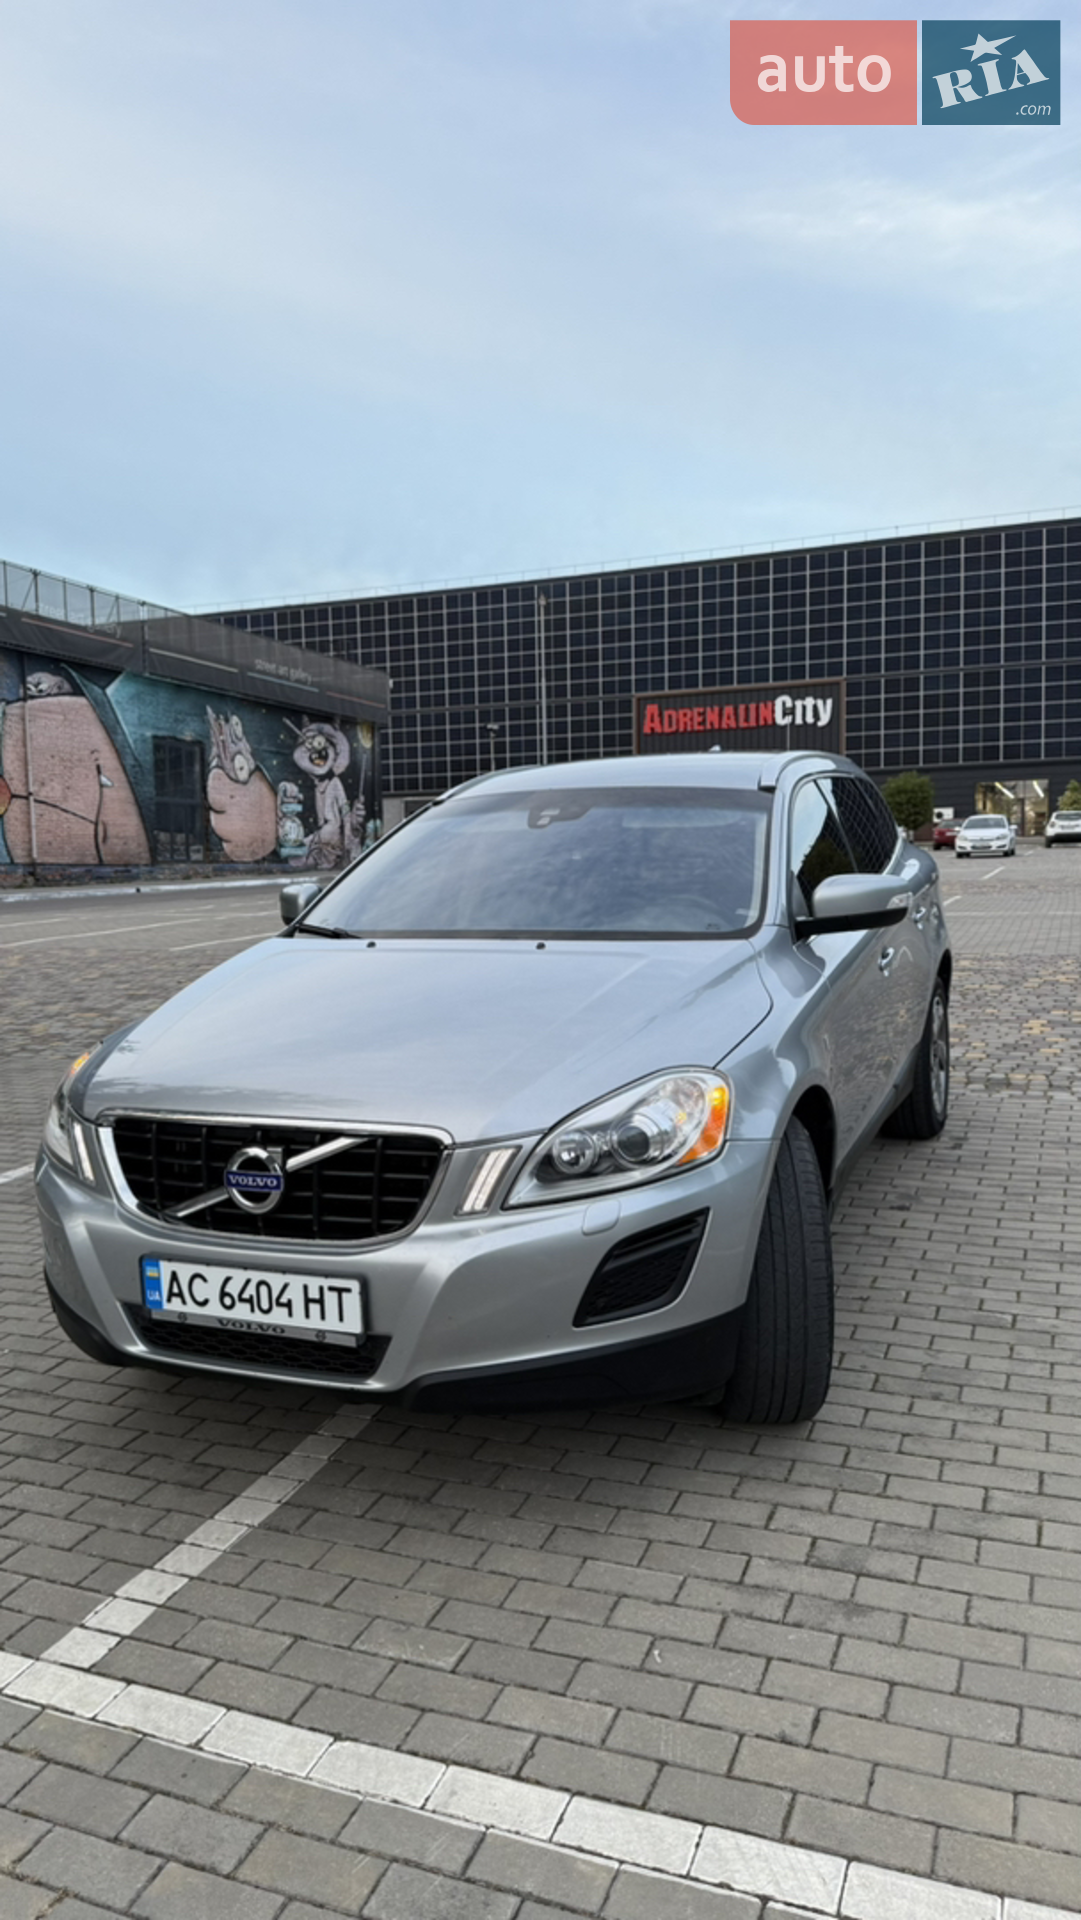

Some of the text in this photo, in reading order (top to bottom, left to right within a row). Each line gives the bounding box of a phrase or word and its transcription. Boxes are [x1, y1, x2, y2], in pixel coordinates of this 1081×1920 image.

[228, 1174, 278, 1187] VOLVO
[147, 1289, 162, 1301] UA
[166, 1269, 352, 1323] AC 6404 HT
[217, 1319, 286, 1334] VOLVO
